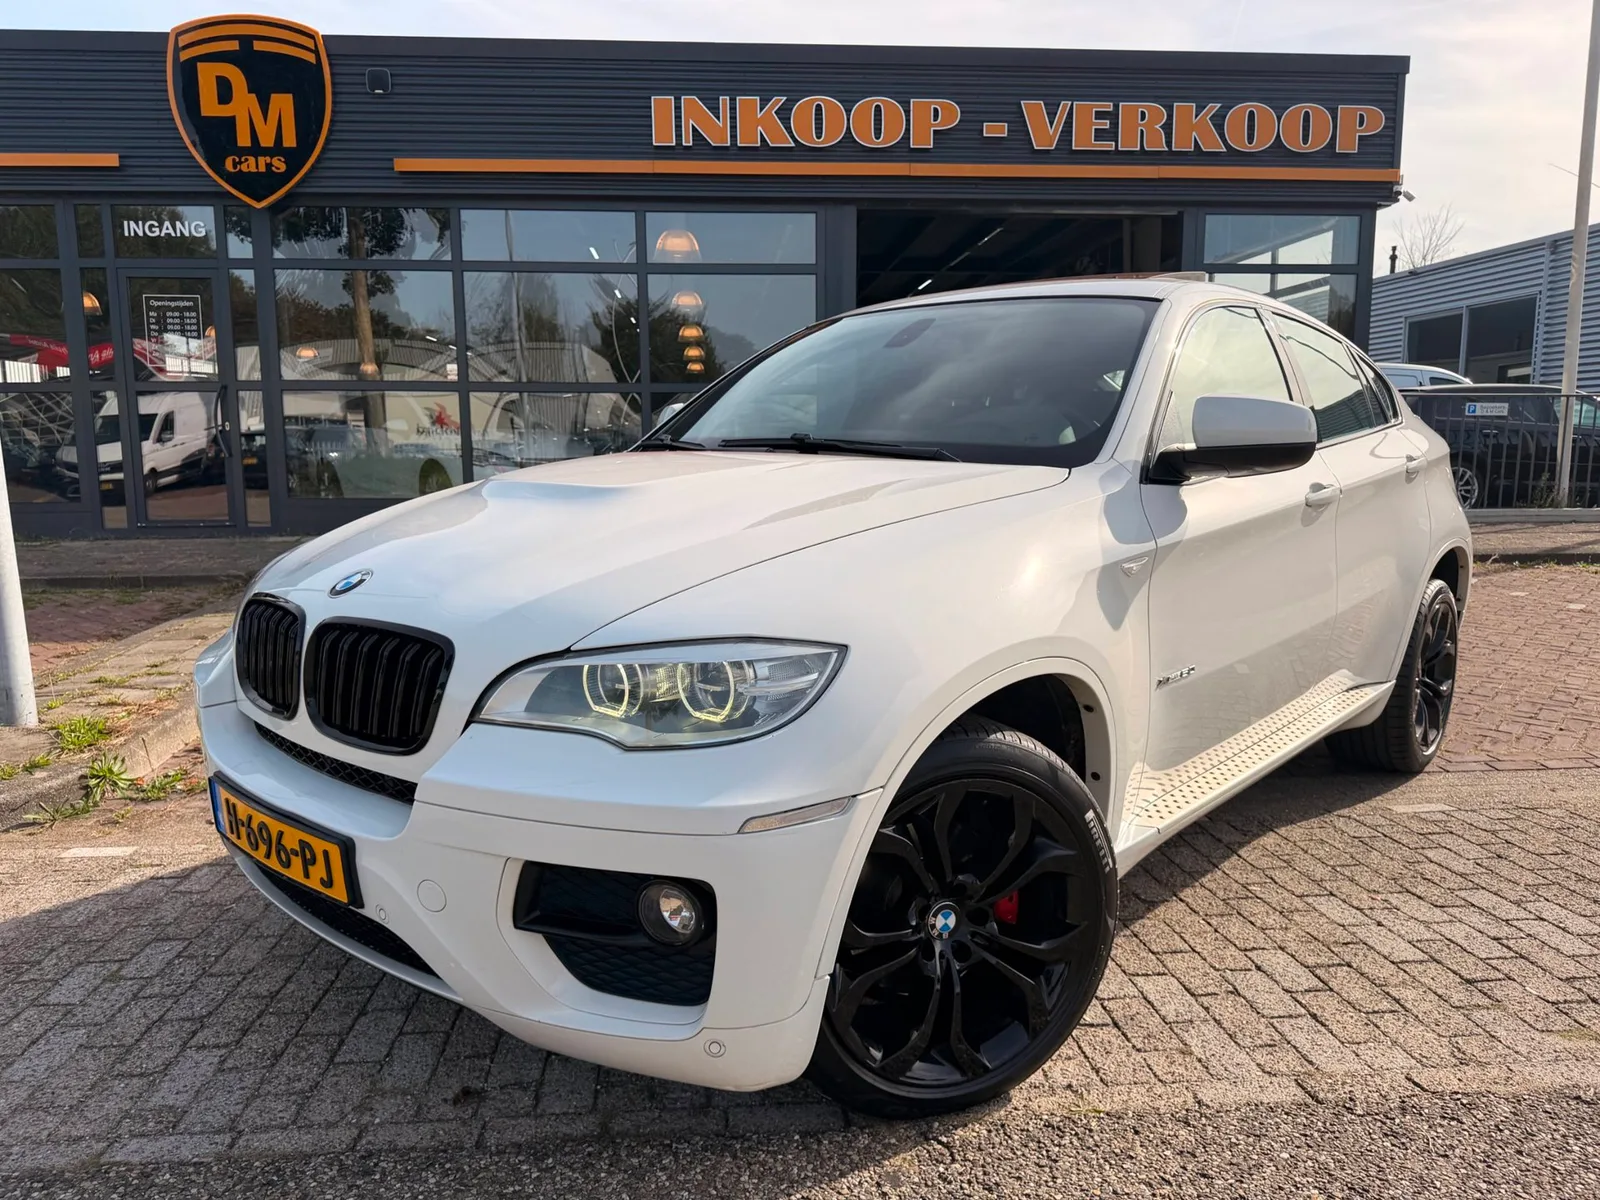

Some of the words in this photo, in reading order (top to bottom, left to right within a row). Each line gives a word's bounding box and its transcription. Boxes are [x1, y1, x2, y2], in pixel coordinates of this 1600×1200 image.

[651, 95, 961, 149] INKOOP
[983, 122, 1008, 137] -
[1020, 100, 1385, 153] VERKOOP
[224, 155, 287, 172] cars
[123, 220, 206, 237] INGANG
[149, 299, 194, 307] Openingstijden
[224, 797, 333, 889] H-696-PJ
[1084, 808, 1113, 874] PIRELLI
